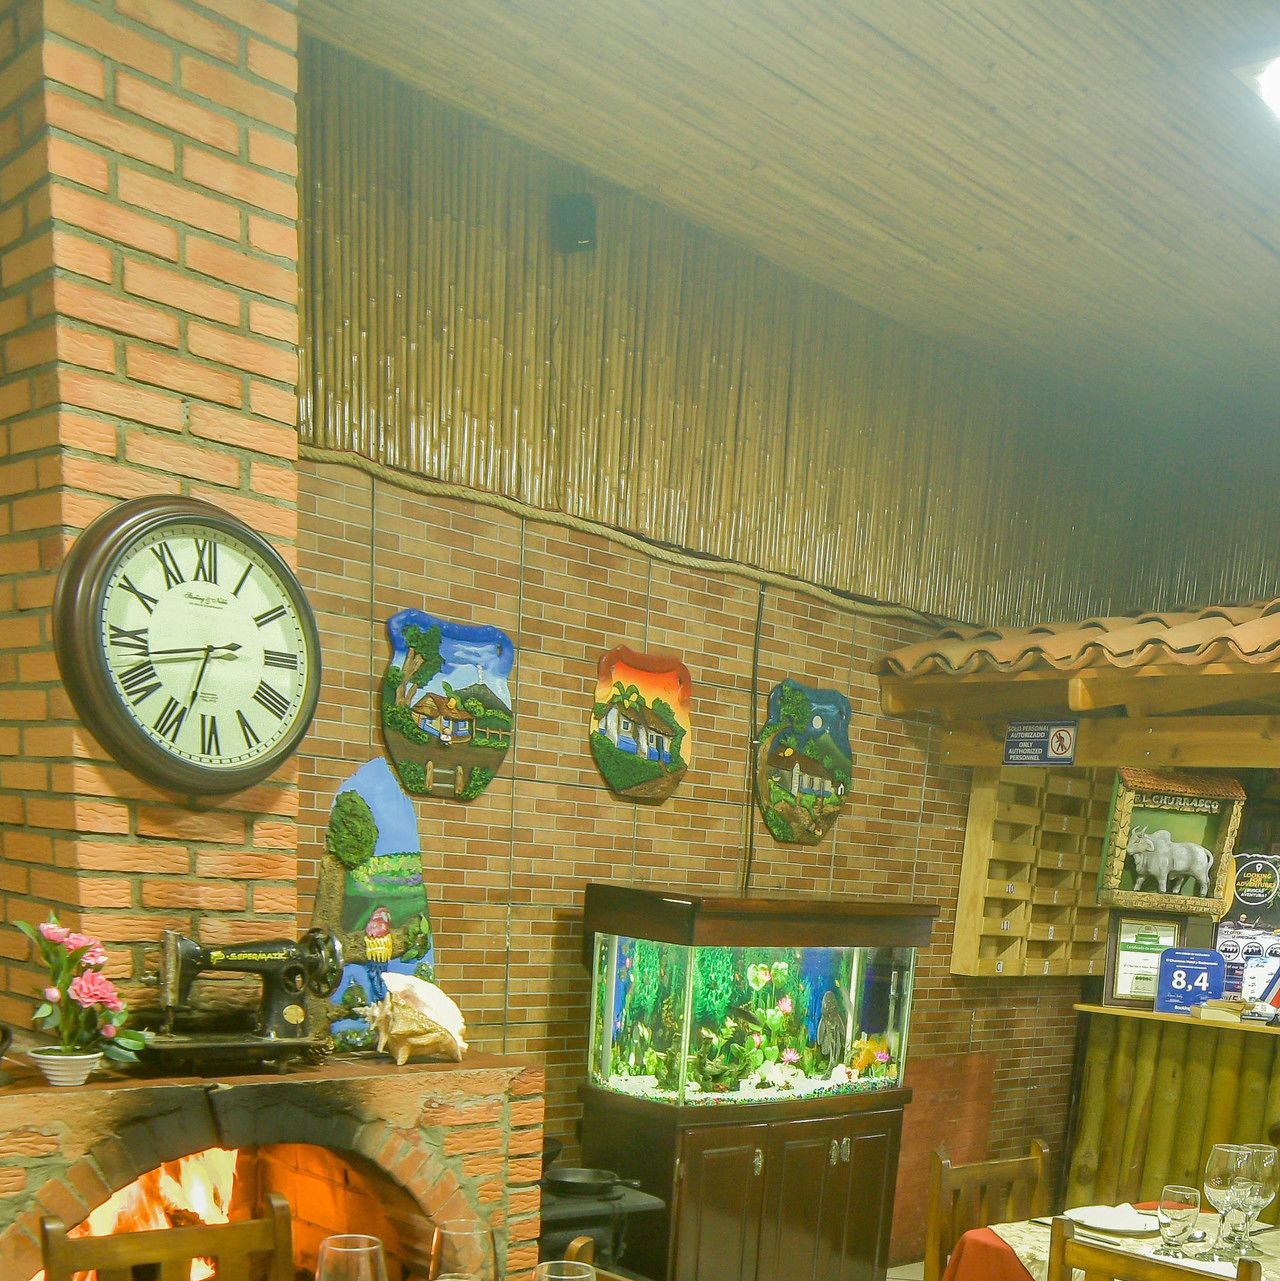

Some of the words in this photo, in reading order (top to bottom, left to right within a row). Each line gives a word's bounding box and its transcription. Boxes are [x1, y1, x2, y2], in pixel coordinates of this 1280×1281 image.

[149, 541, 186, 590] XI
[192, 537, 219, 585] XII
[232, 562, 254, 597] I
[117, 574, 159, 614] X
[252, 604, 287, 628] II
[109, 624, 149, 651] IX
[263, 649, 298, 671] III
[117, 661, 163, 706] VIII
[252, 680, 292, 720] IIII
[152, 696, 188, 744] VII
[200, 713, 221, 756] VI
[235, 709, 262, 748] V
[1022, 724, 1049, 732] PERSONAL
[1152, 794, 1220, 809] CHURRASCO
[1171, 969, 1209, 992] 8,4
